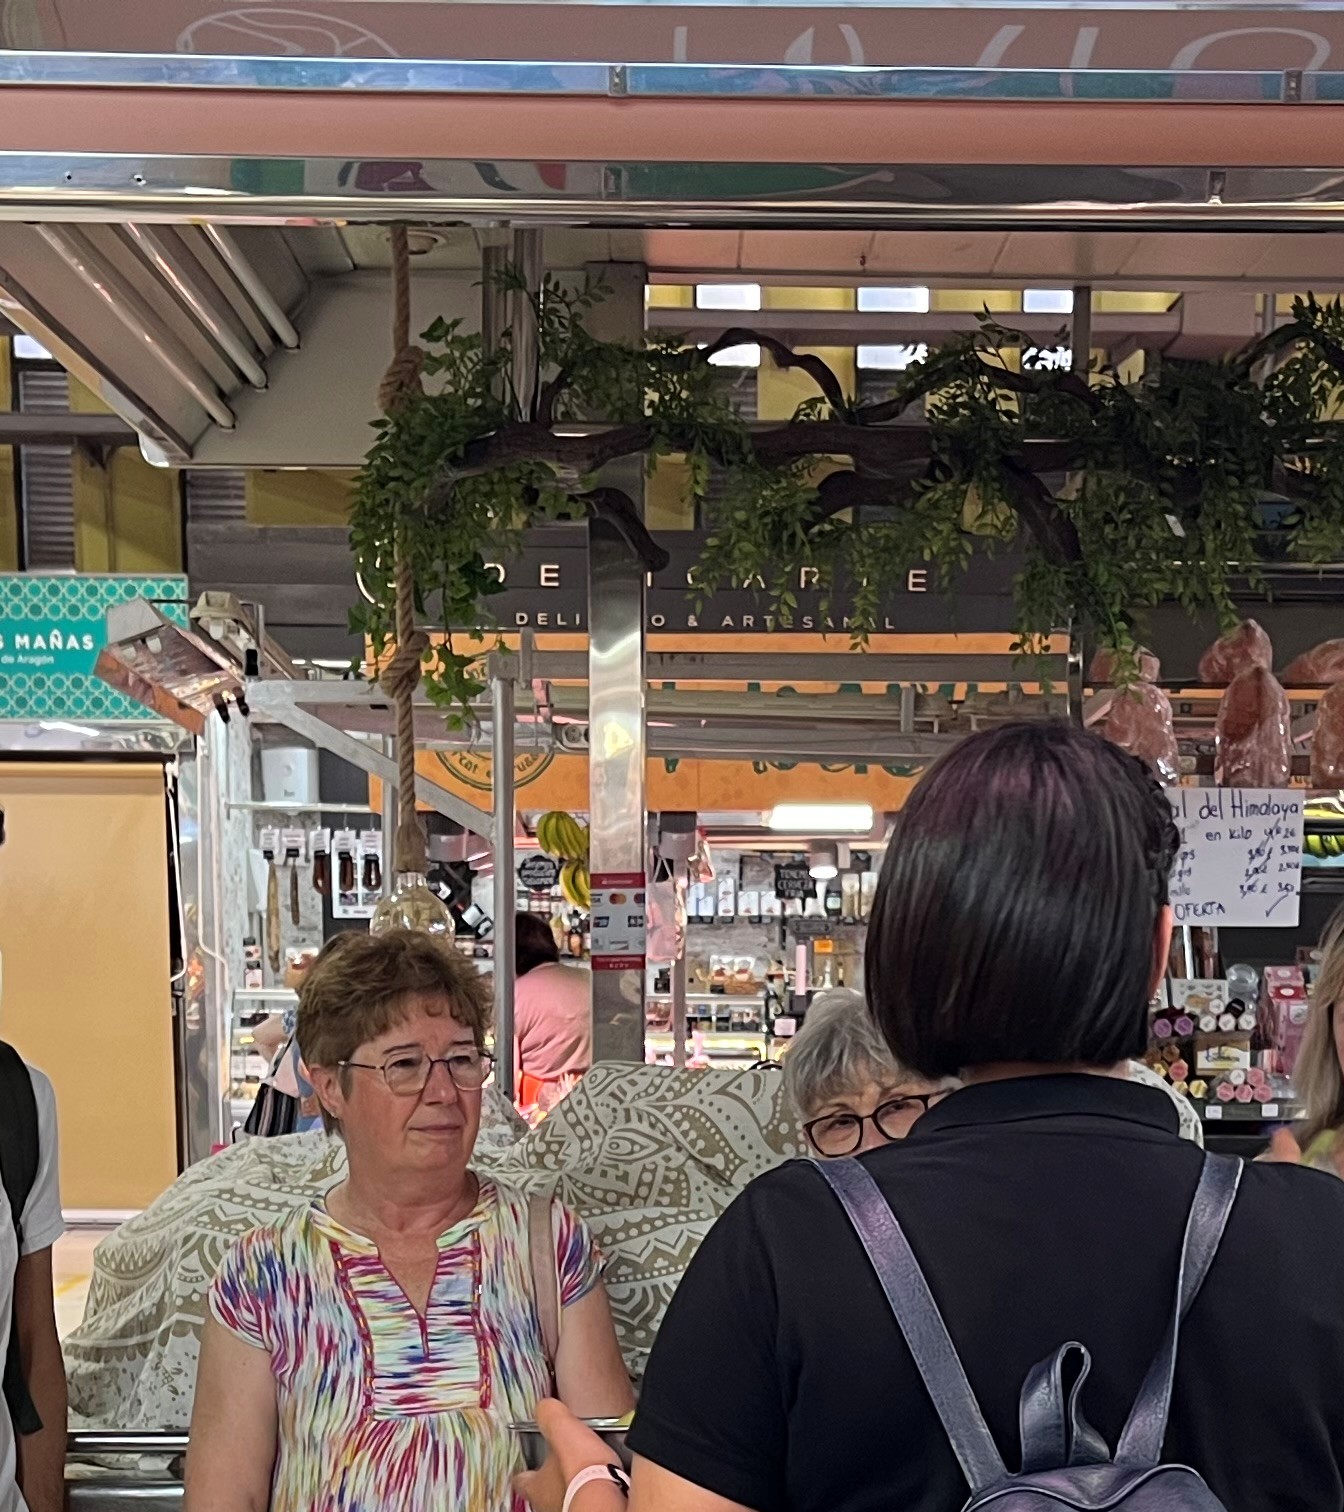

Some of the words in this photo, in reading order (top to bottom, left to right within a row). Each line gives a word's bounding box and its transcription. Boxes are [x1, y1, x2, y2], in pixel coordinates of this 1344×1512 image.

[516, 612, 666, 627] DELIO
[14, 629, 94, 650] MAÑAS
[1, 653, 15, 664] de
[1199, 789, 1223, 820] del
[1231, 789, 1299, 821] Himalaya
[1205, 832, 1222, 841] en
[1175, 901, 1226, 921] OFERTA
